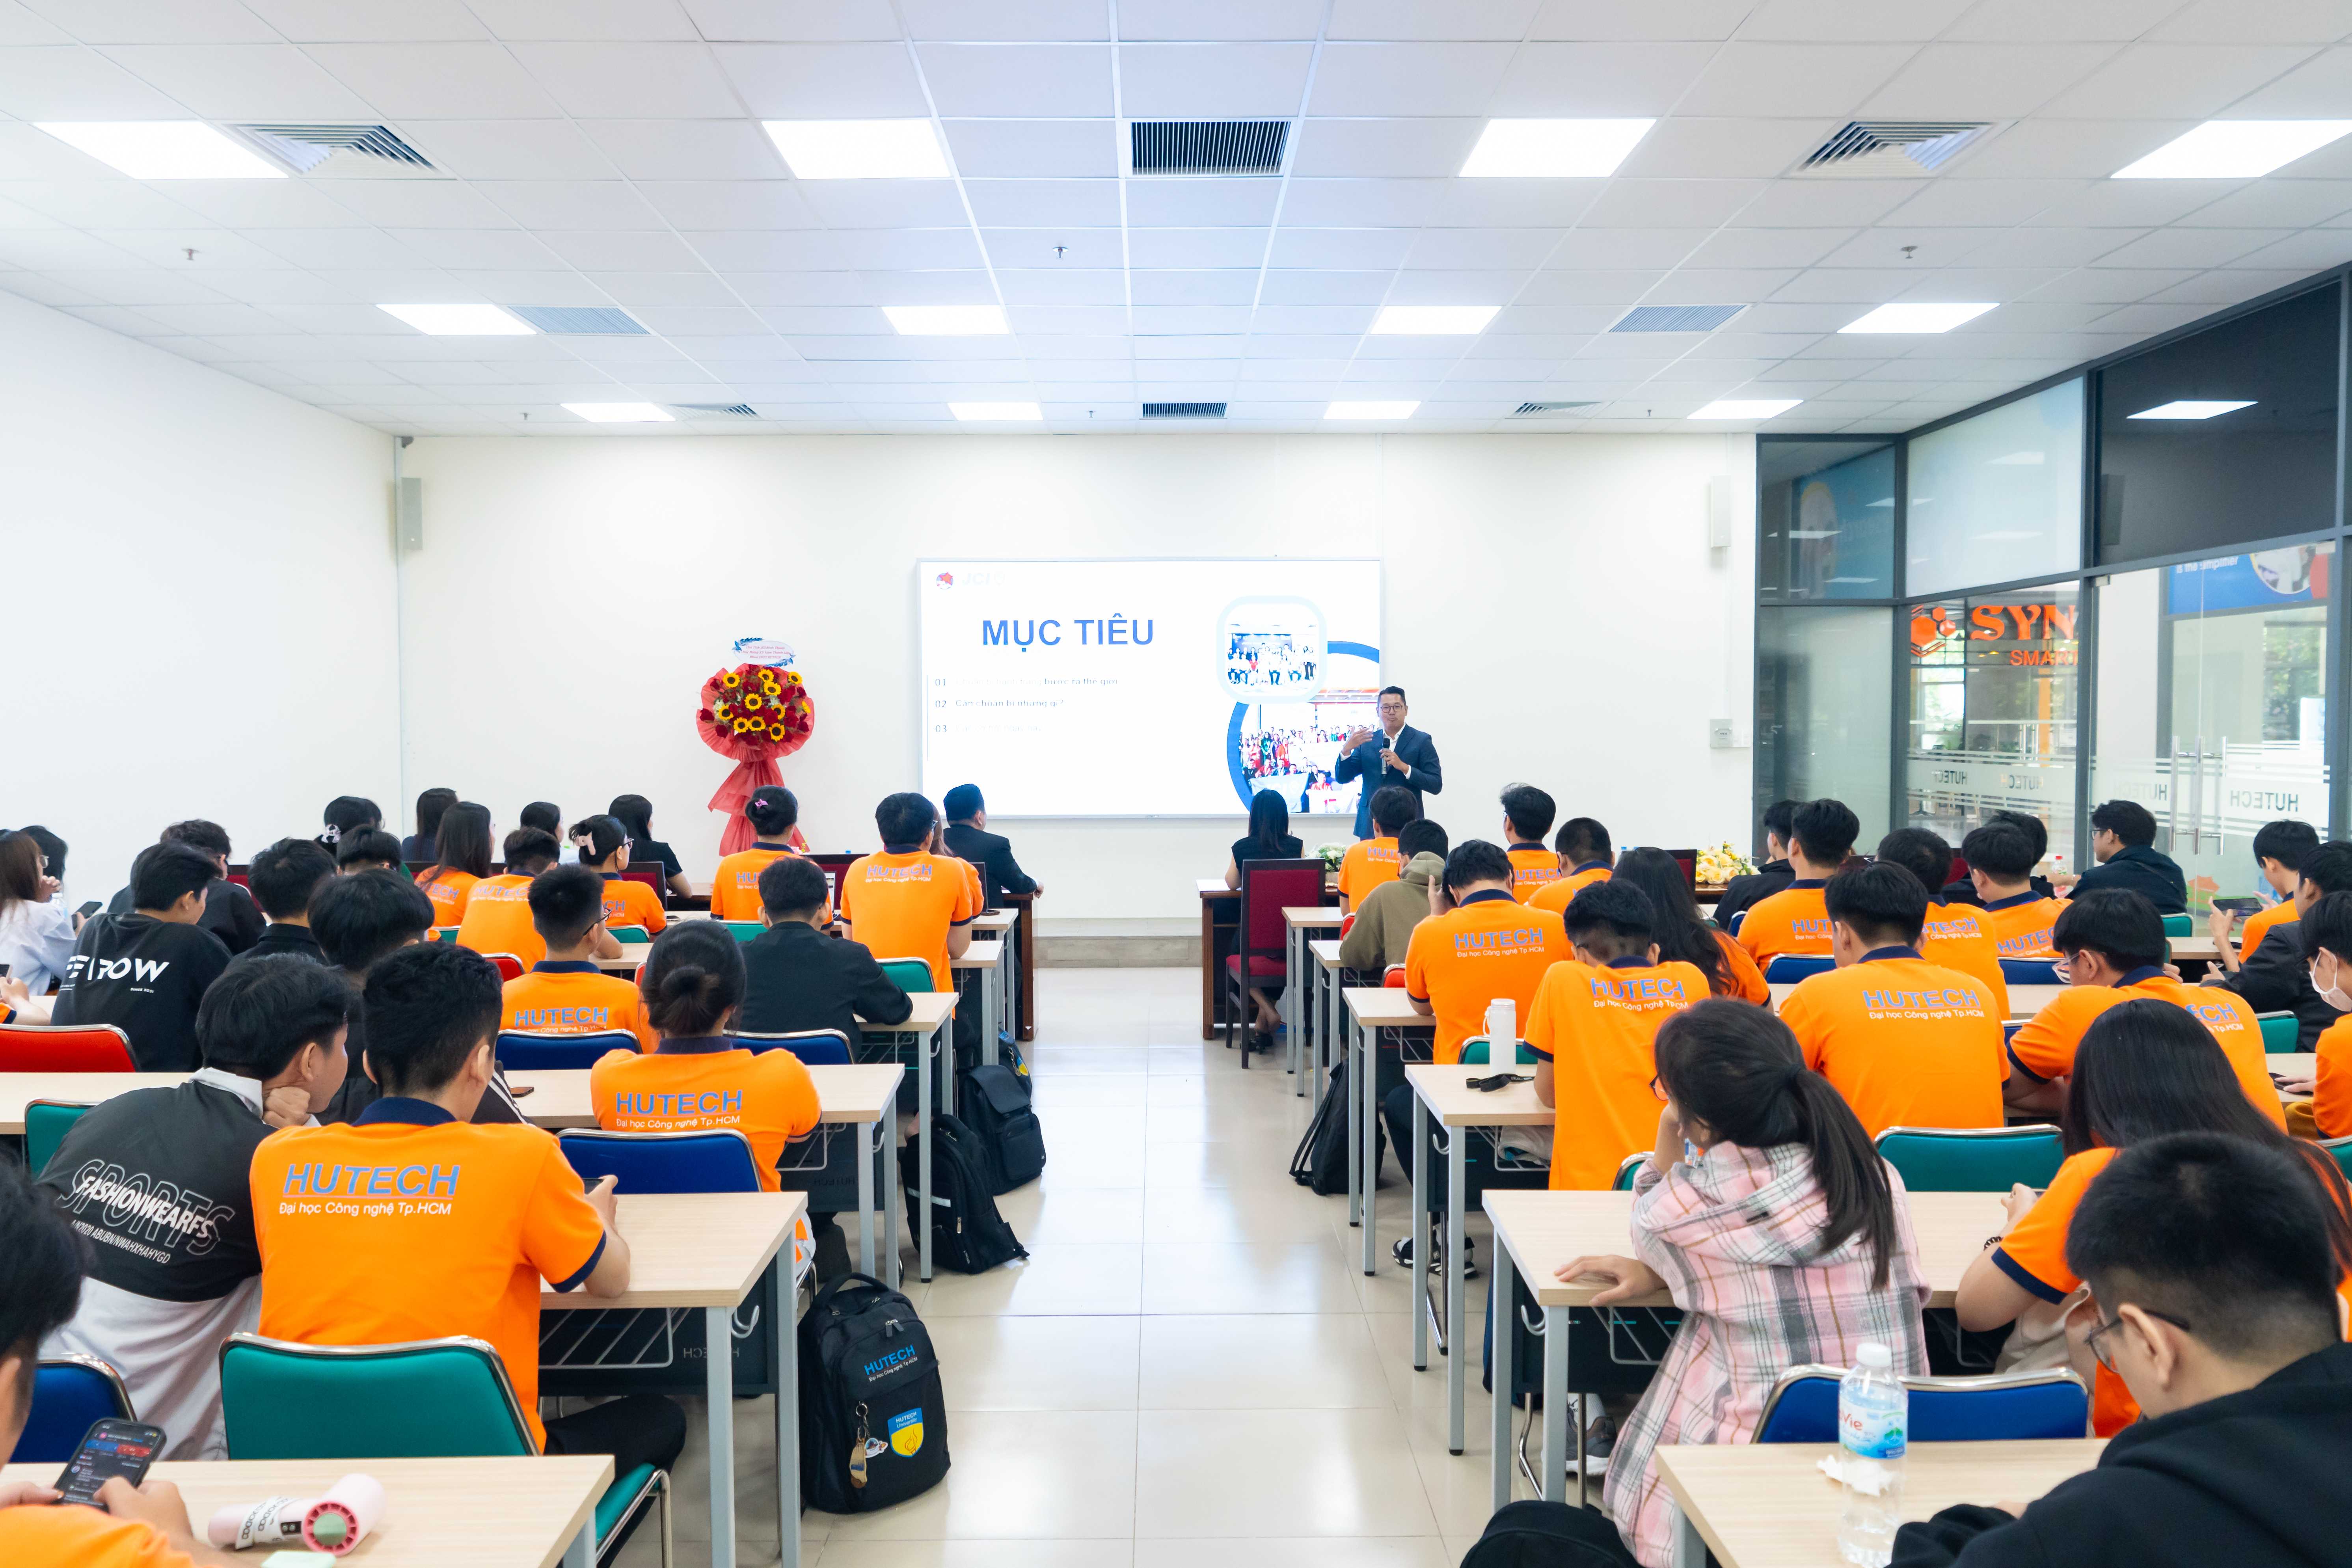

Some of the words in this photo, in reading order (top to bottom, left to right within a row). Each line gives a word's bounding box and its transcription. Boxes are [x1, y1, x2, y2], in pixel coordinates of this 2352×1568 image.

[983, 620, 1061, 653] MỤC
[1075, 613, 1153, 645] TIÊU
[2010, 650, 2078, 666] SMART
[935, 678, 946, 687] 01
[935, 724, 947, 733] 03
[867, 863, 933, 877] HUTECH
[1516, 868, 1560, 880] UTEC
[428, 883, 460, 899] ECH
[473, 885, 529, 896] HUTEC
[1792, 919, 1830, 932] HUT
[1923, 917, 1979, 933] TECH
[1454, 927, 1543, 949] HUTECH
[1997, 926, 2054, 953] HUTEC
[1591, 977, 1685, 999] HUTECH
[1594, 1000, 1605, 1008] Đại
[1622, 1002, 1642, 1012] Công
[1644, 1000, 1664, 1010] nghệ
[1862, 989, 1980, 1008] HUTECH
[515, 1007, 609, 1027] HUTECH
[1885, 1011, 1902, 1019] học
[1904, 1011, 1929, 1020] Công
[1930, 1010, 1952, 1020] nghệ
[1952, 1009, 1985, 1018] Tp.HCM
[2185, 1003, 2239, 1022] ECH
[616, 1089, 742, 1115] HUTECH
[616, 1118, 628, 1127] Đại
[629, 1119, 645, 1129] học
[647, 1120, 672, 1129] Công
[674, 1118, 698, 1128] nghệ
[701, 1115, 740, 1127] Tp.HCM
[283, 1163, 461, 1196] HUTECH
[56, 1159, 236, 1255] SPORTS
[75, 1175, 215, 1238] FASHIONWEARFS
[279, 1202, 296, 1216] Đại
[298, 1202, 322, 1216] học
[325, 1201, 359, 1217] Công
[363, 1202, 394, 1217] nghệ
[397, 1202, 452, 1216] Tp.HCM
[864, 1345, 915, 1376] HUTECH
[896, 1411, 917, 1423] HUTECH
[896, 1417, 917, 1428] University
